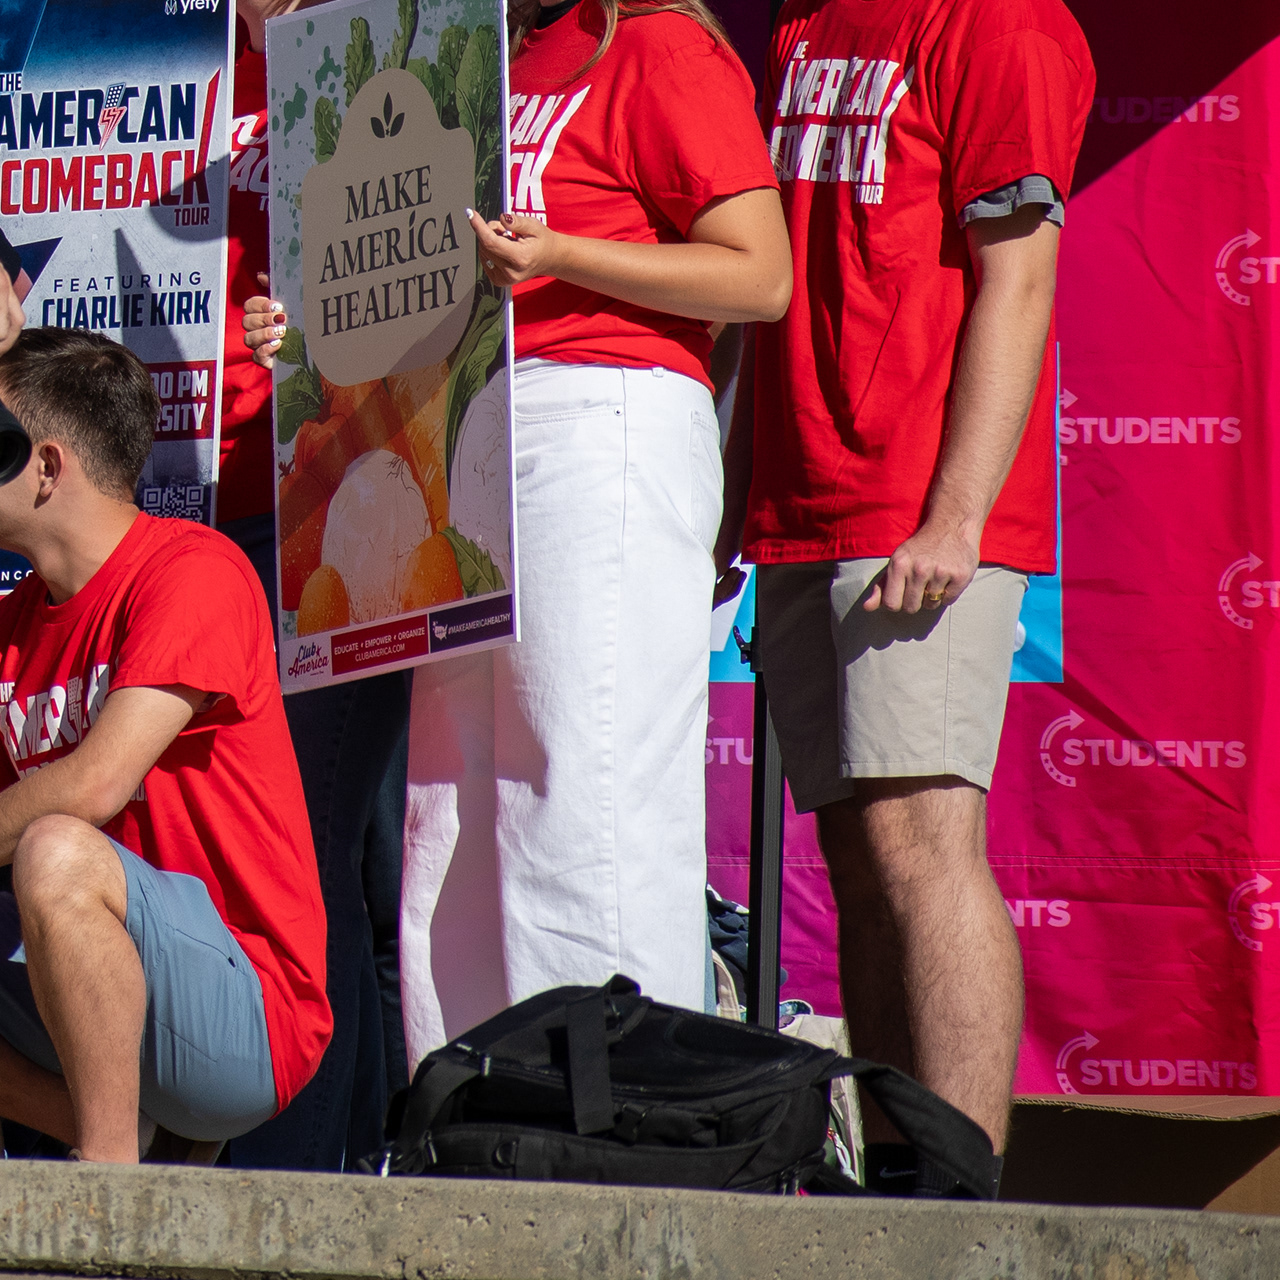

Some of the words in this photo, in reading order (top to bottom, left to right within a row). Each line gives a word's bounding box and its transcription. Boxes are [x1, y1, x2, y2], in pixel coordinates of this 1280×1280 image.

[1, 129, 210, 216] COMEBACK
[344, 164, 433, 225] MAKE
[174, 207, 210, 227] TOUR
[319, 210, 460, 284] AMERICA
[53, 271, 203, 293] FEATURING
[42, 296, 143, 331] CHARLIE
[150, 289, 211, 328] KIRK
[320, 264, 461, 338] HEALTHY
[178, 370, 209, 398] PM
[1059, 416, 1242, 445] STUDENTS
[448, 612, 511, 635] #MAKEAMERICAHEALTHY
[296, 641, 317, 663] Club
[334, 642, 359, 656] EDUCATE
[365, 635, 392, 648] EMPOWER
[397, 626, 426, 640] ORGANIZE
[354, 643, 406, 662] CLUBAMERICA.COM
[288, 654, 329, 678] America
[1063, 738, 1247, 768] STUDENTS
[1081, 1059, 1257, 1090] STUDENTS
